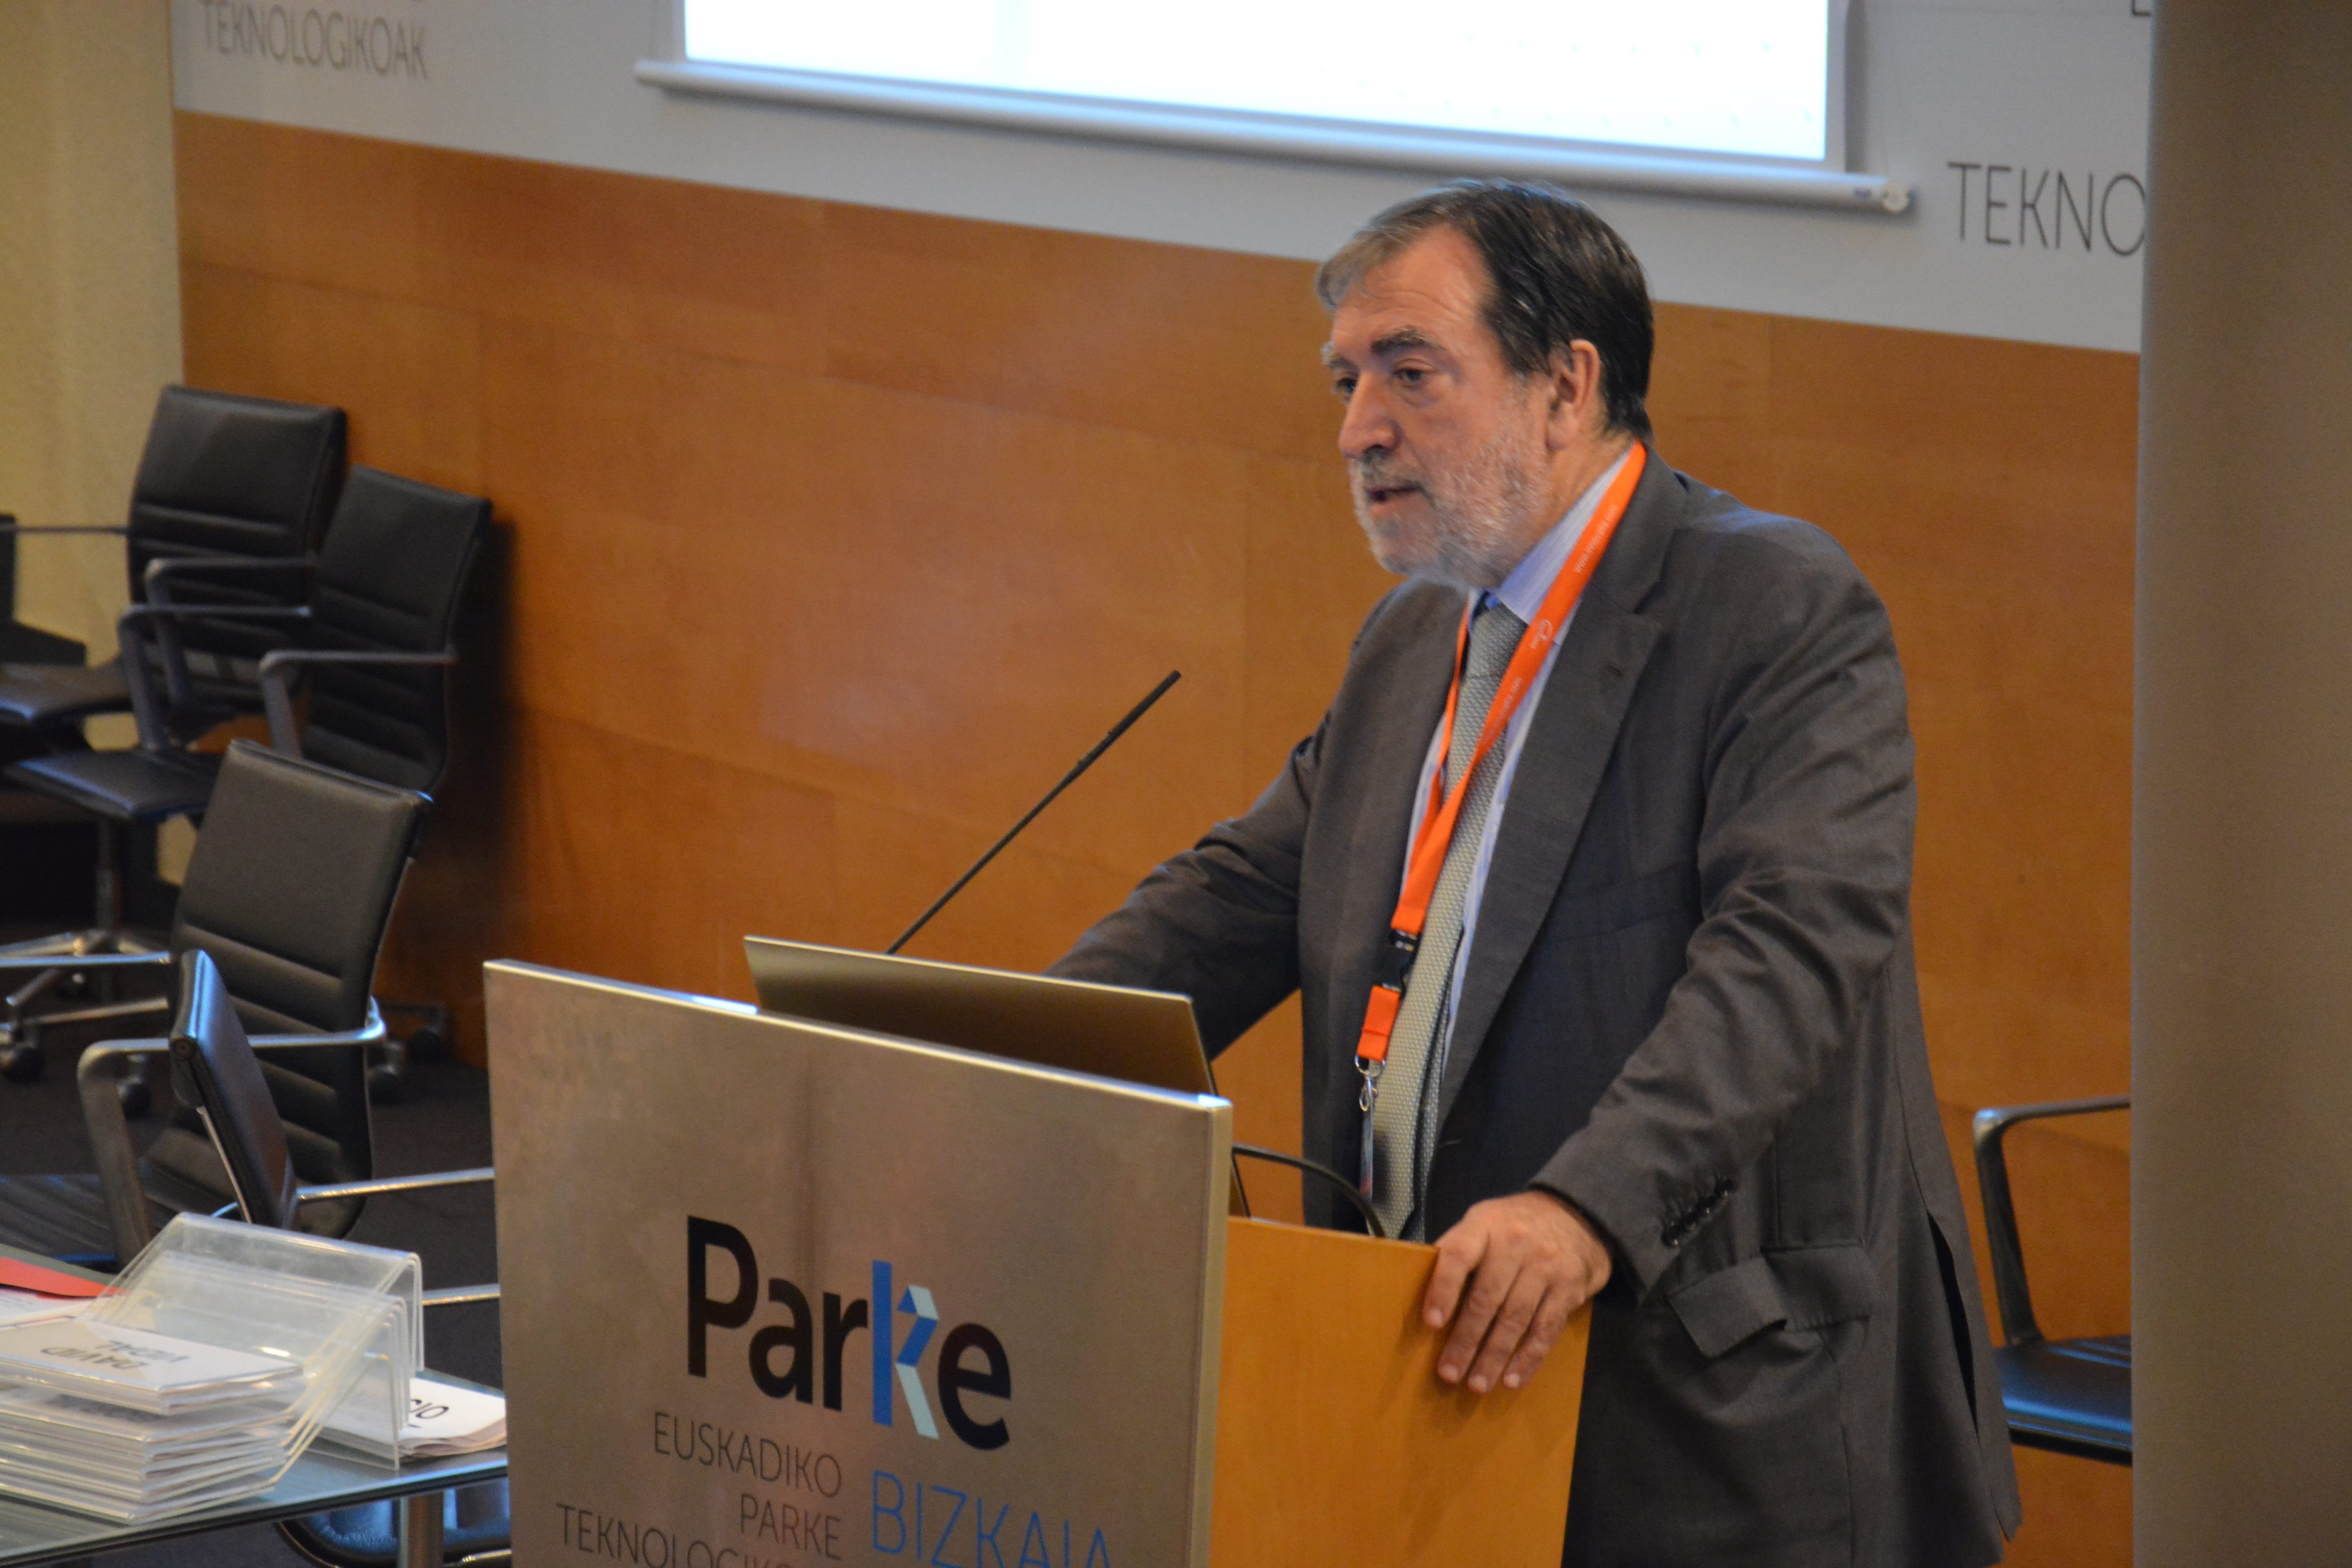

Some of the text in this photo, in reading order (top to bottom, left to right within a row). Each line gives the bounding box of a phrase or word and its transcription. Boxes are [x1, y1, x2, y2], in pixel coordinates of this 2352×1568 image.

[200, 0, 428, 80] TEKNOLOGIKOAK
[1947, 162, 2145, 256] TEKNO
[687, 1215, 1011, 1450] Parke
[654, 1411, 842, 1497] EUSKADIKO
[741, 1494, 841, 1560] PARKE
